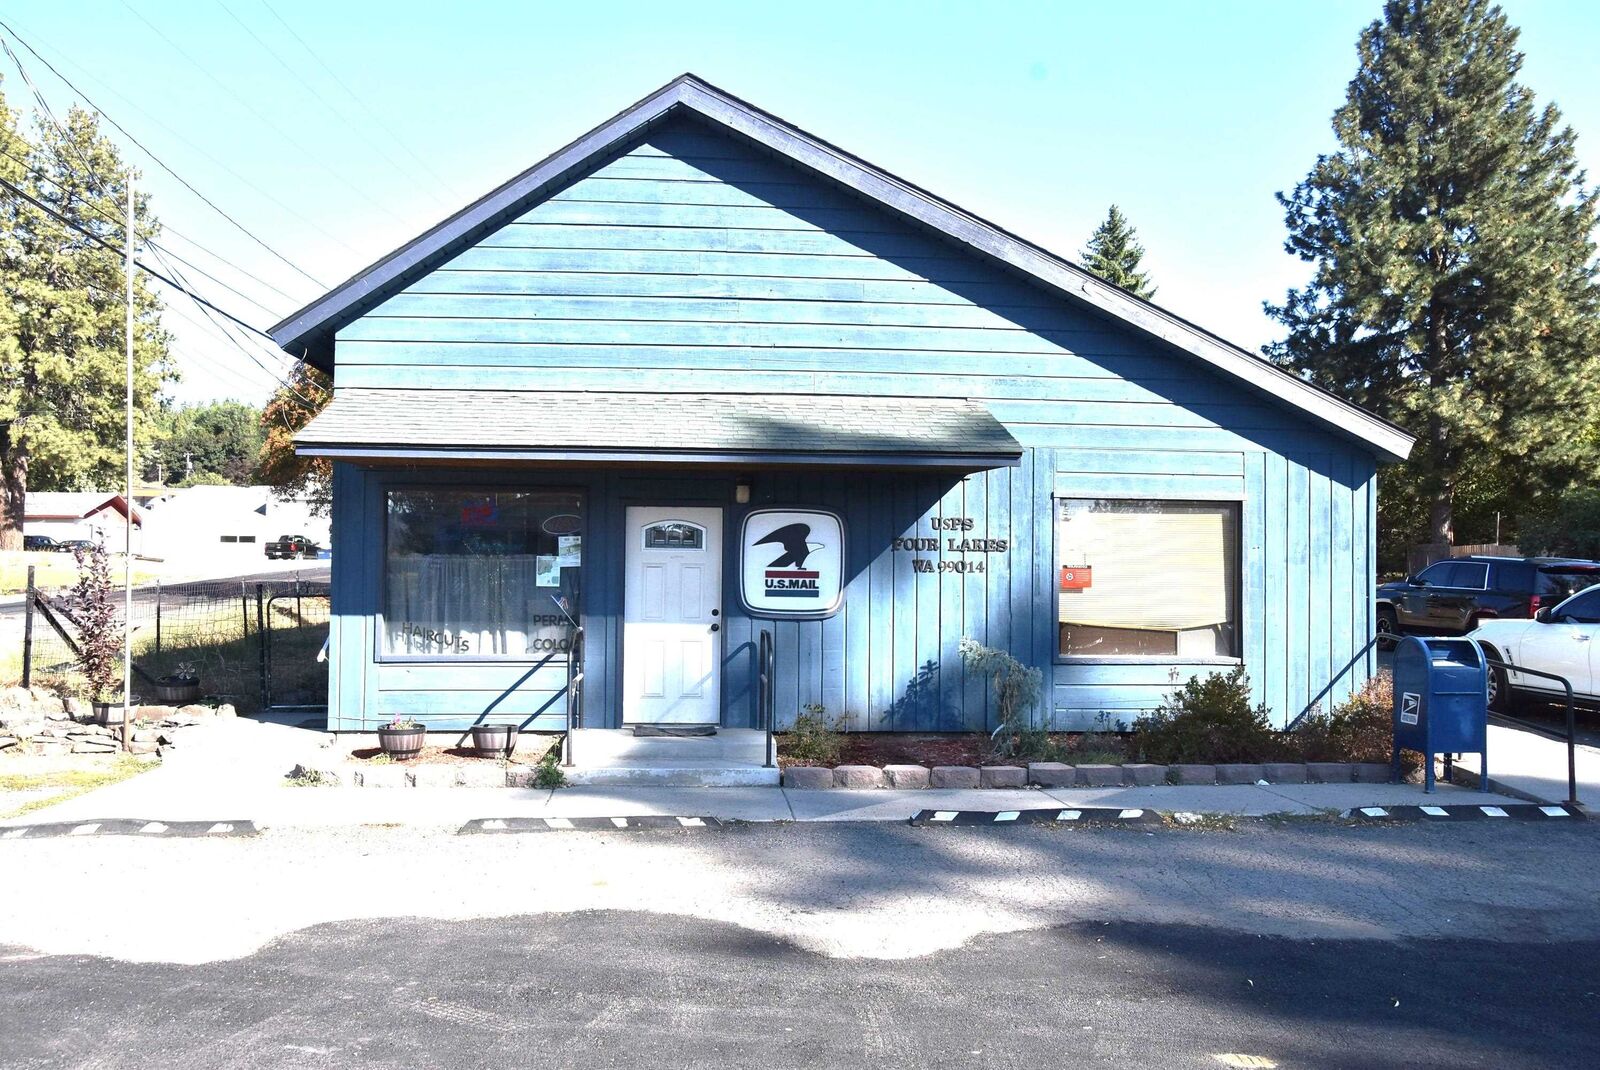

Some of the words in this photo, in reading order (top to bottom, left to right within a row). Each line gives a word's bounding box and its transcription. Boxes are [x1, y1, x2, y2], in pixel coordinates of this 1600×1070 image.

[930, 517, 975, 532] USPS
[891, 537, 940, 552] FOUR
[947, 538, 1009, 553] LAKES
[912, 559, 936, 573] WA
[937, 560, 985, 574] 99014
[402, 622, 470, 652] HAIRCUTS
[533, 638, 570, 650] COLO
